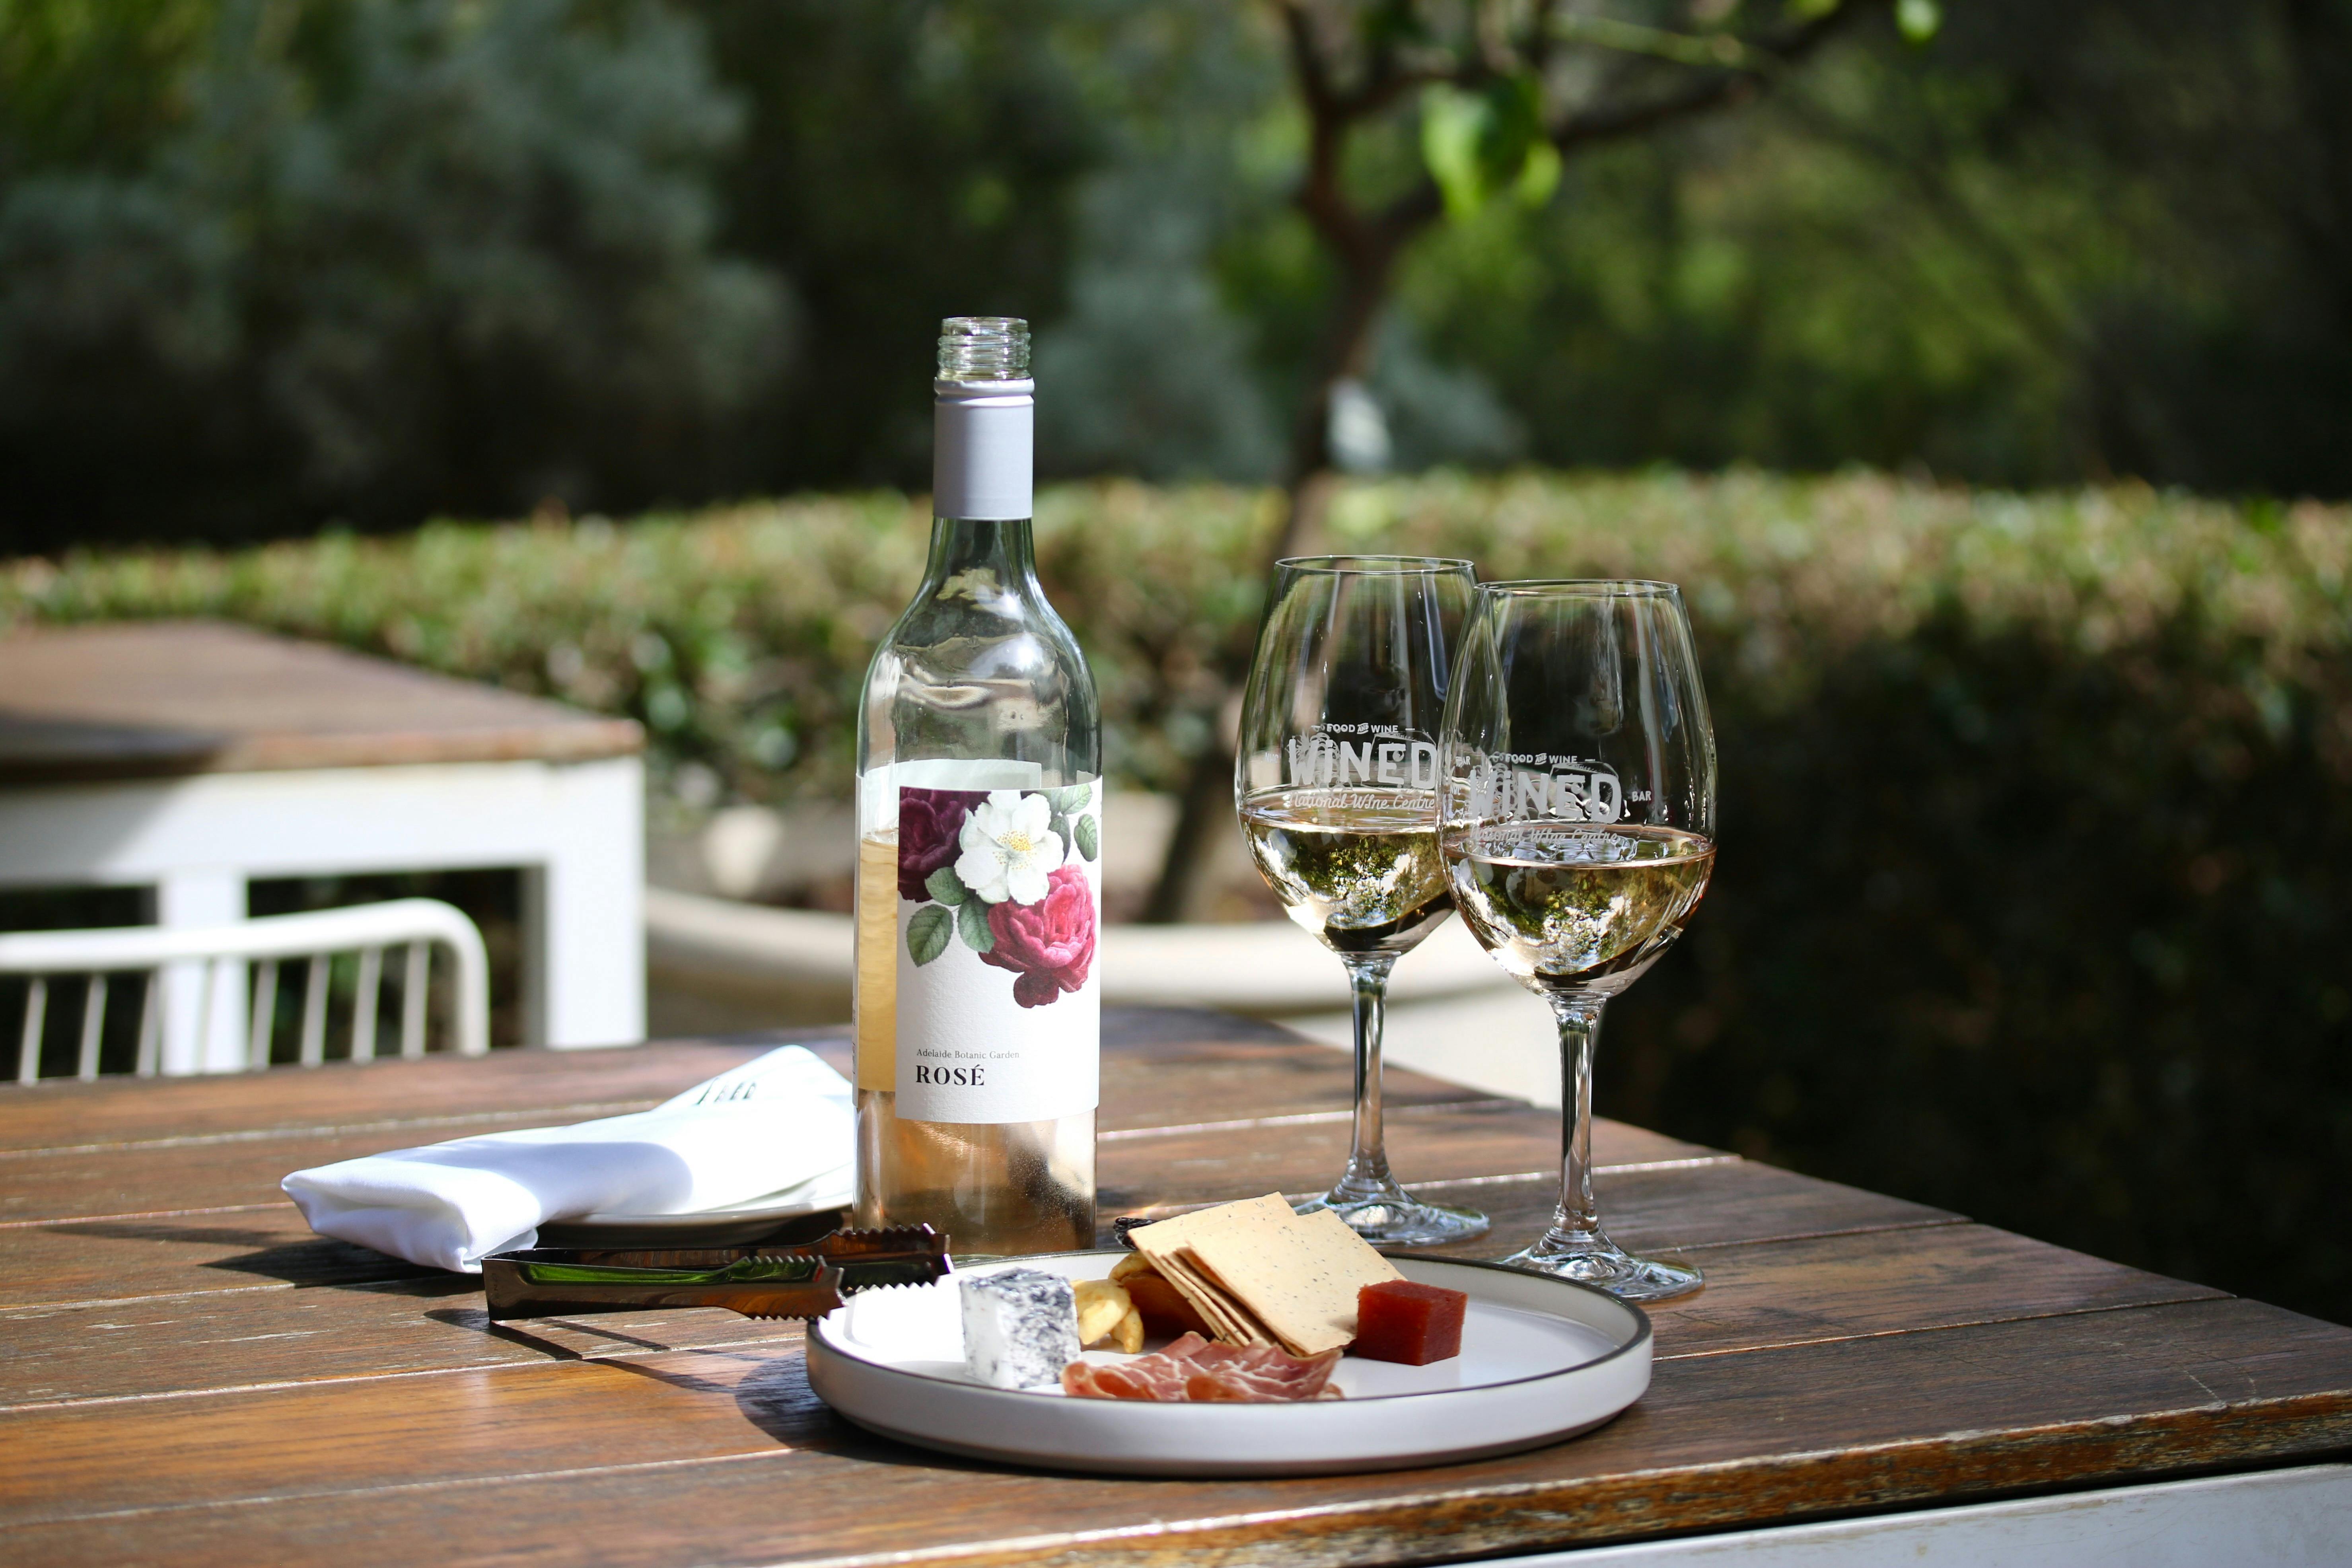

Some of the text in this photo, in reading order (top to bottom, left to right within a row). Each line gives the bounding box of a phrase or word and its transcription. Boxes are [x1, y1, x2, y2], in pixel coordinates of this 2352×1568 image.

[1327, 724, 1356, 733] FOOD
[1371, 725, 1399, 733] WINE
[1505, 753, 1533, 764] FOOD
[1549, 755, 1578, 763] WINE
[1290, 791, 1435, 809] National Wine Centre
[1632, 790, 1652, 802] BAR
[1572, 829, 1619, 844] Centre
[916, 1049, 951, 1058] Adelaide
[955, 1050, 986, 1059] Botanic
[916, 1064, 984, 1086] ROSÉ
